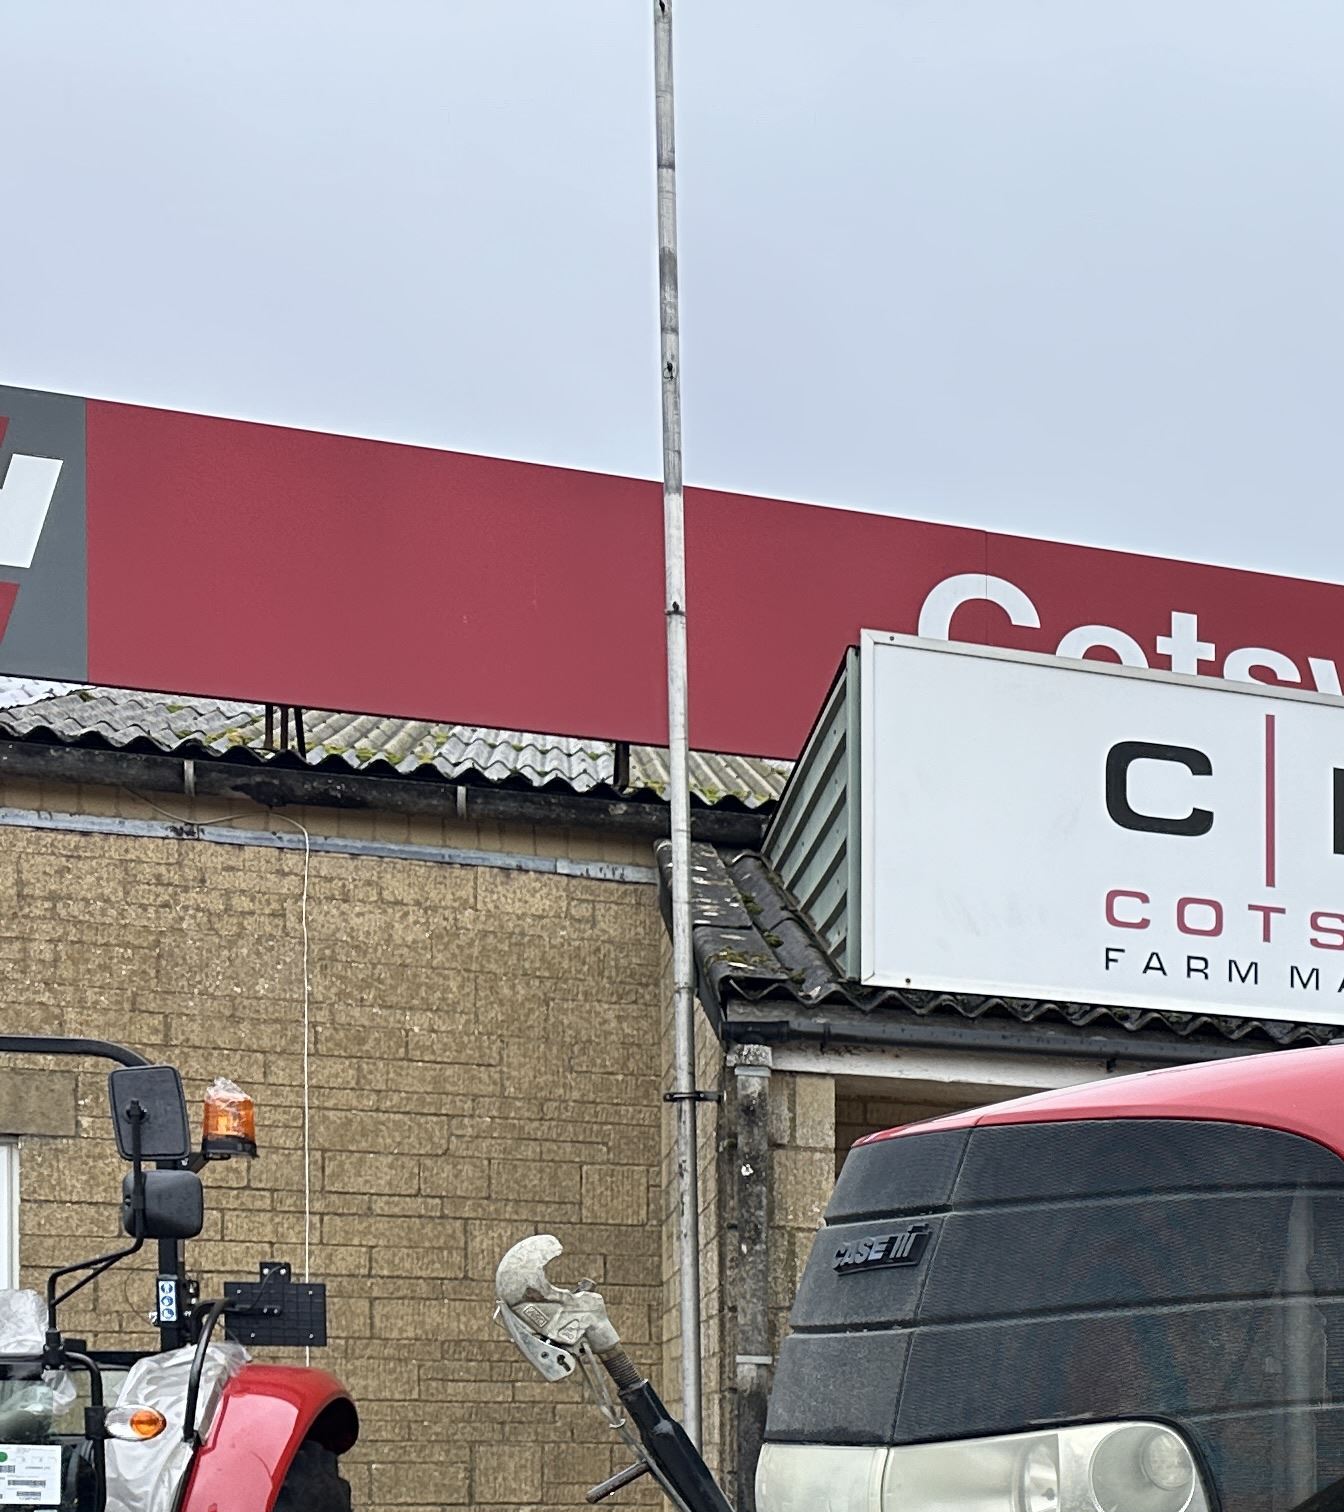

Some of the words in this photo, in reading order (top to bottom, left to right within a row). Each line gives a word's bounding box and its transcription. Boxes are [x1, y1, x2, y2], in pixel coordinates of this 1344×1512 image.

[1105, 741, 1214, 837] C
[1104, 947, 1259, 986] FARM
[833, 1235, 890, 1269] CASE
